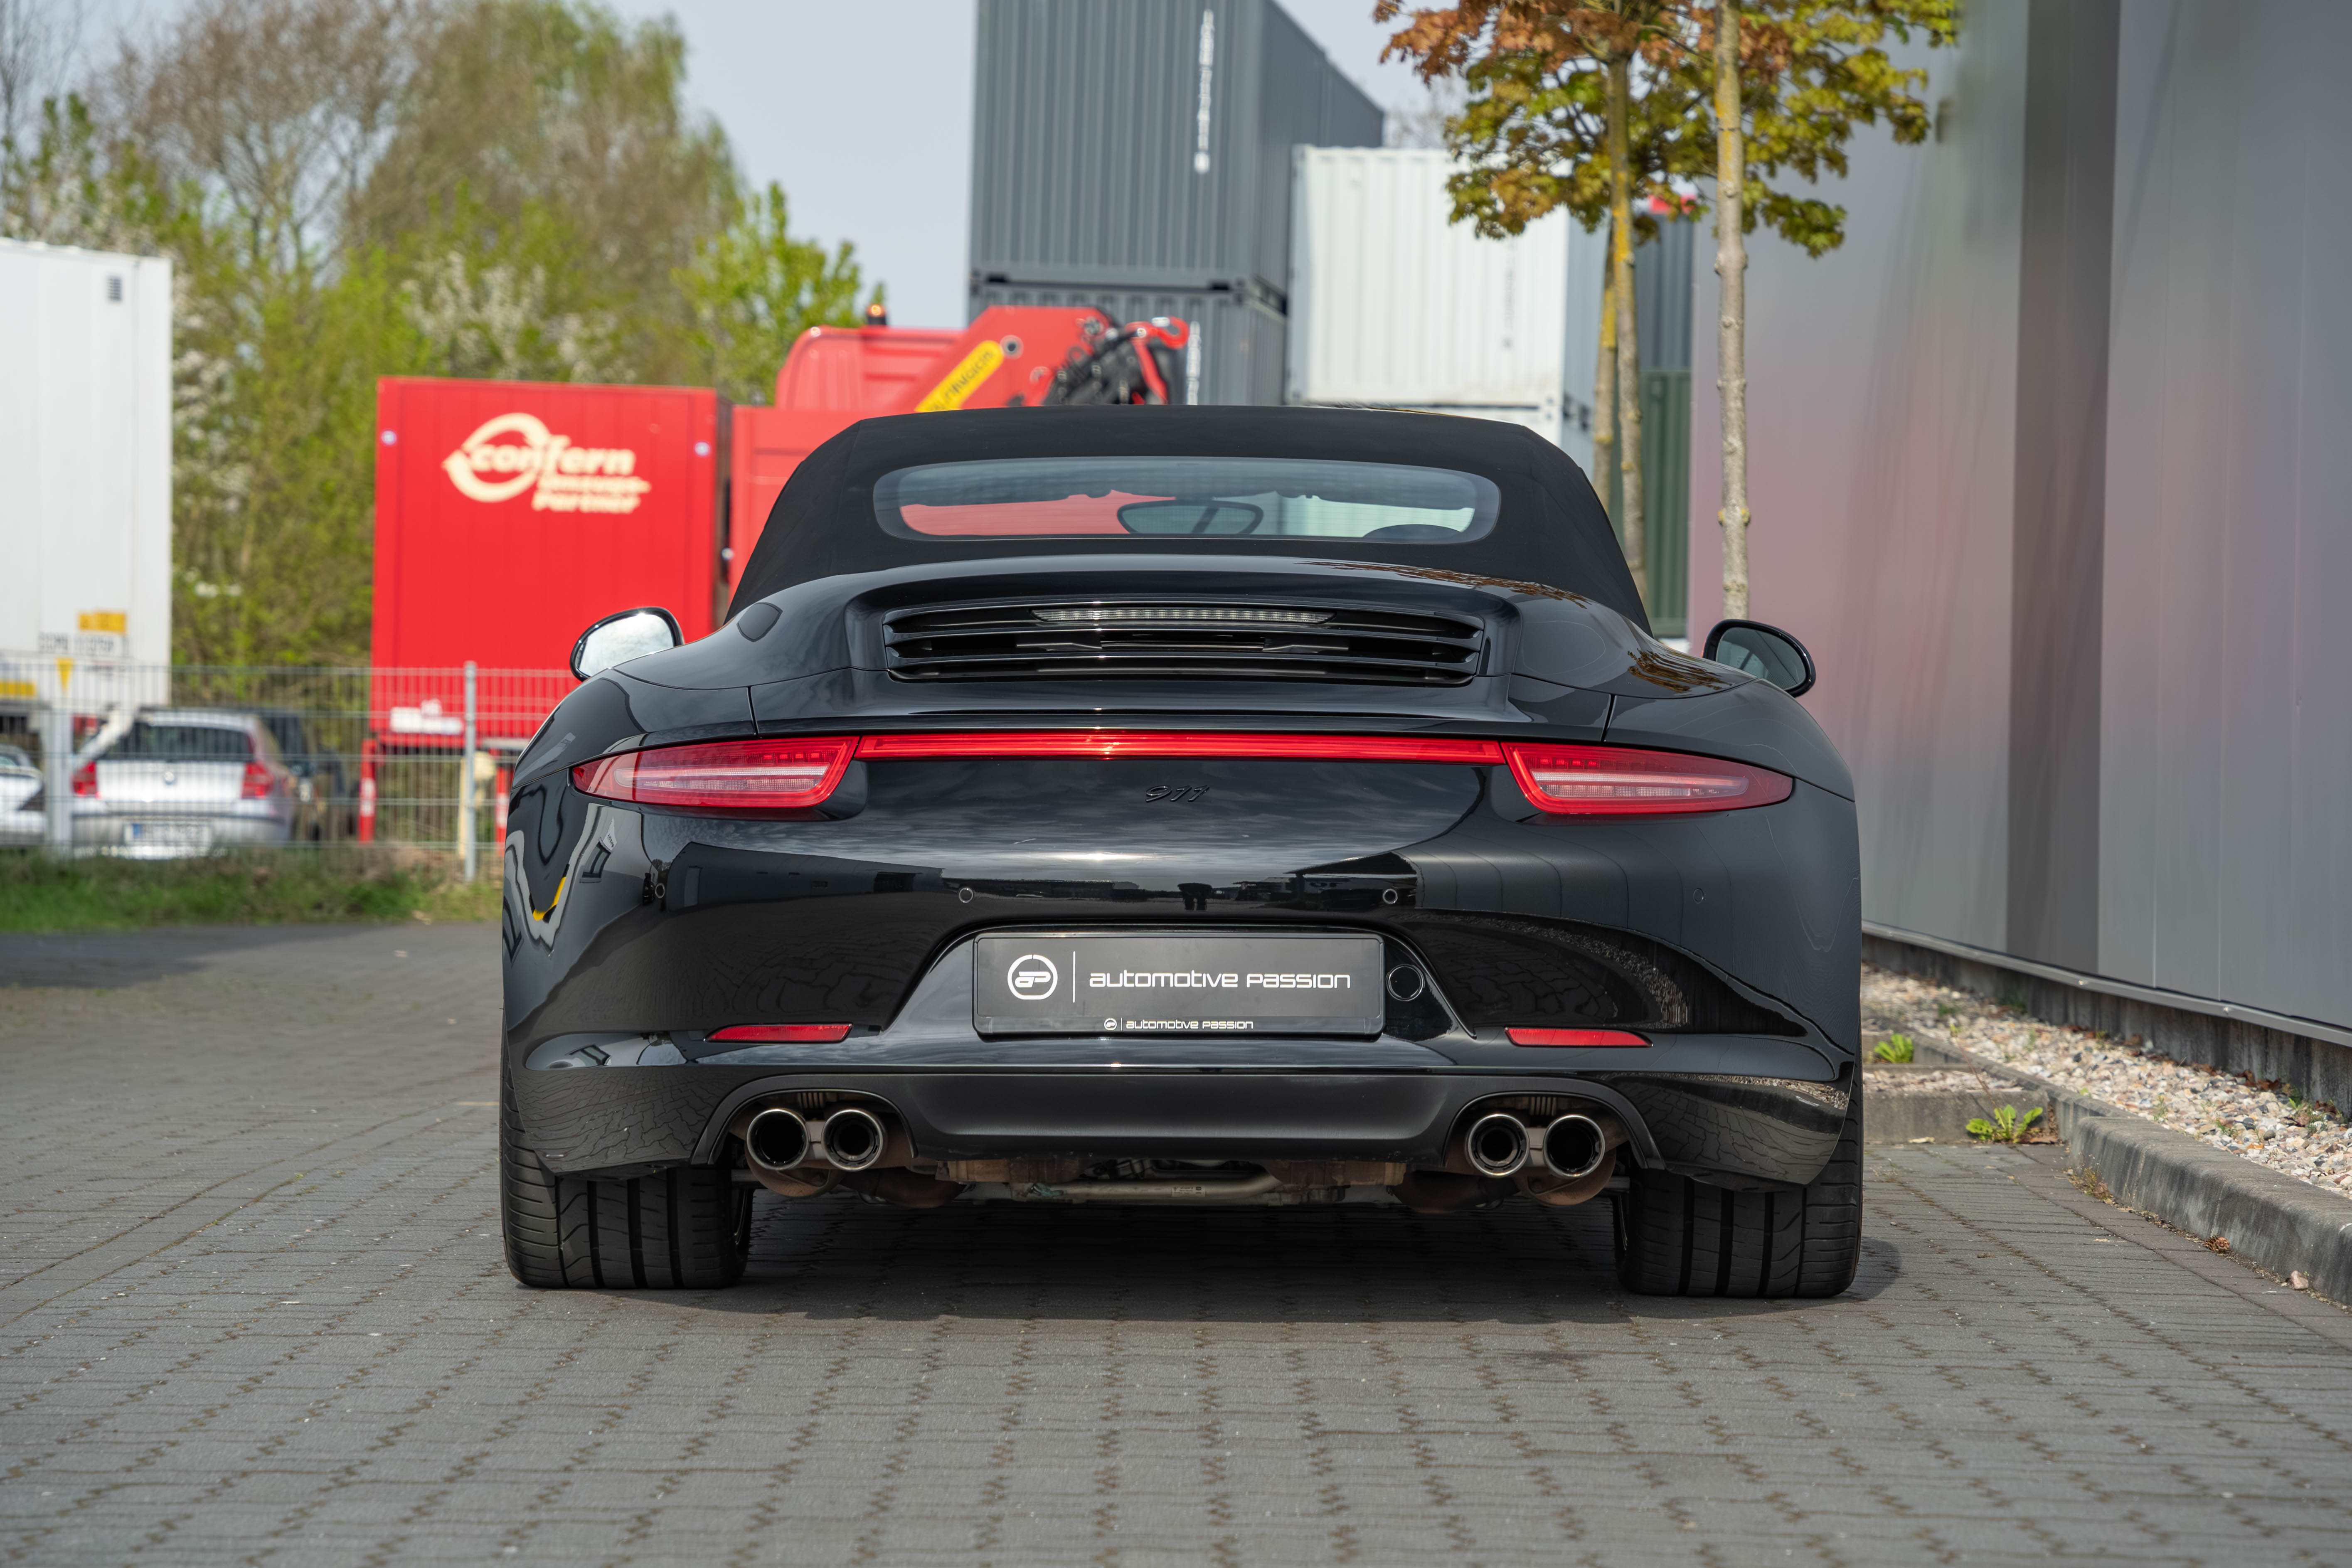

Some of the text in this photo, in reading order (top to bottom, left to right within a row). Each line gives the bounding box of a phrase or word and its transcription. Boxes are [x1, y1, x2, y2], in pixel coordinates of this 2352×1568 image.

[1145, 785, 1210, 802] 911
[1089, 970, 1239, 988] automotive
[1126, 1019, 1199, 1029] automotive
